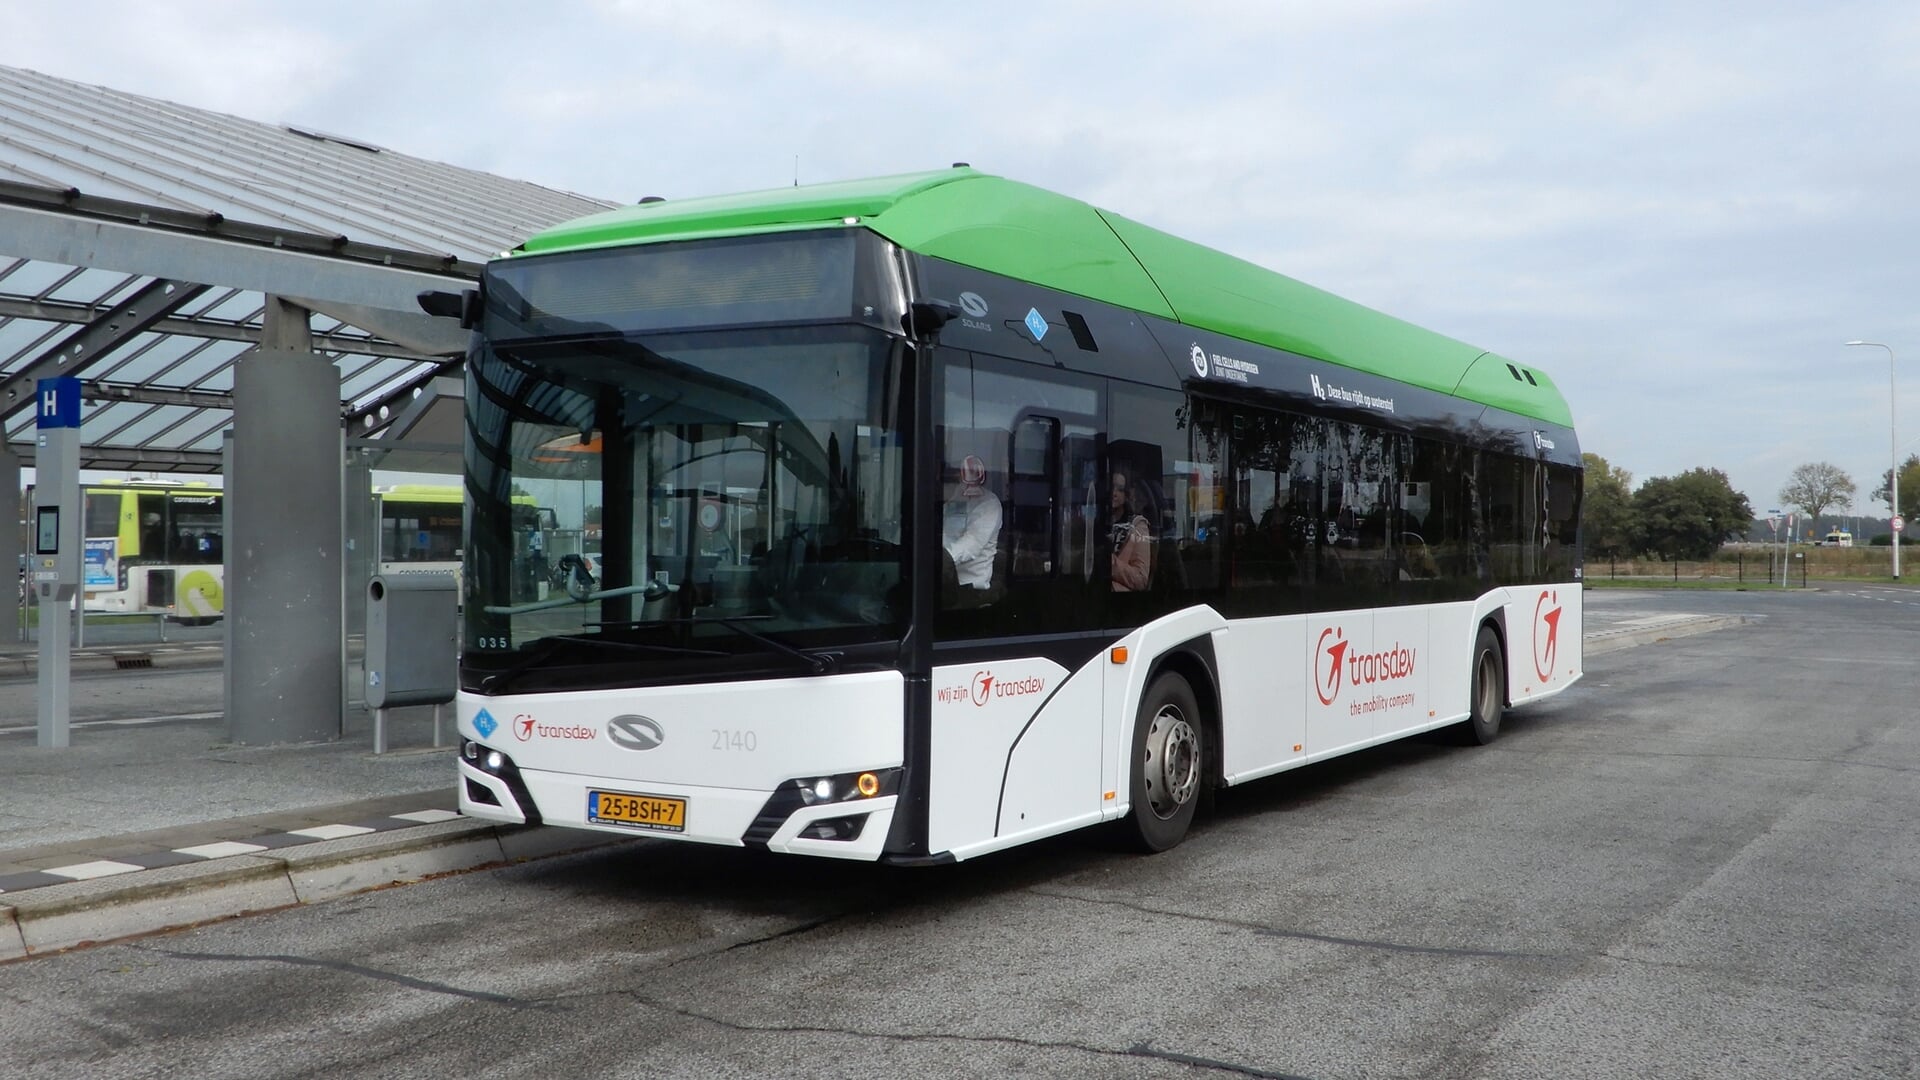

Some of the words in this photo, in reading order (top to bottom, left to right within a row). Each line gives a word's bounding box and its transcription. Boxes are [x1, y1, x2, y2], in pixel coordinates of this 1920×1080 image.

[962, 319, 992, 332] SOLARIS
[44, 389, 57, 417] H
[1327, 384, 1342, 399] Deze
[1341, 387, 1352, 402] bus
[1352, 390, 1364, 406] rijdt
[1363, 394, 1371, 408] op
[1348, 641, 1416, 686] transdev
[938, 687, 951, 704] Wij
[953, 685, 968, 702] zijn
[995, 675, 1045, 697] transdev
[1350, 699, 1361, 716] the
[1362, 695, 1388, 712] mobility
[1389, 692, 1415, 709] company
[537, 724, 597, 740] transdev
[711, 729, 757, 752] 2140
[602, 797, 677, 821] 25-BSH-7
